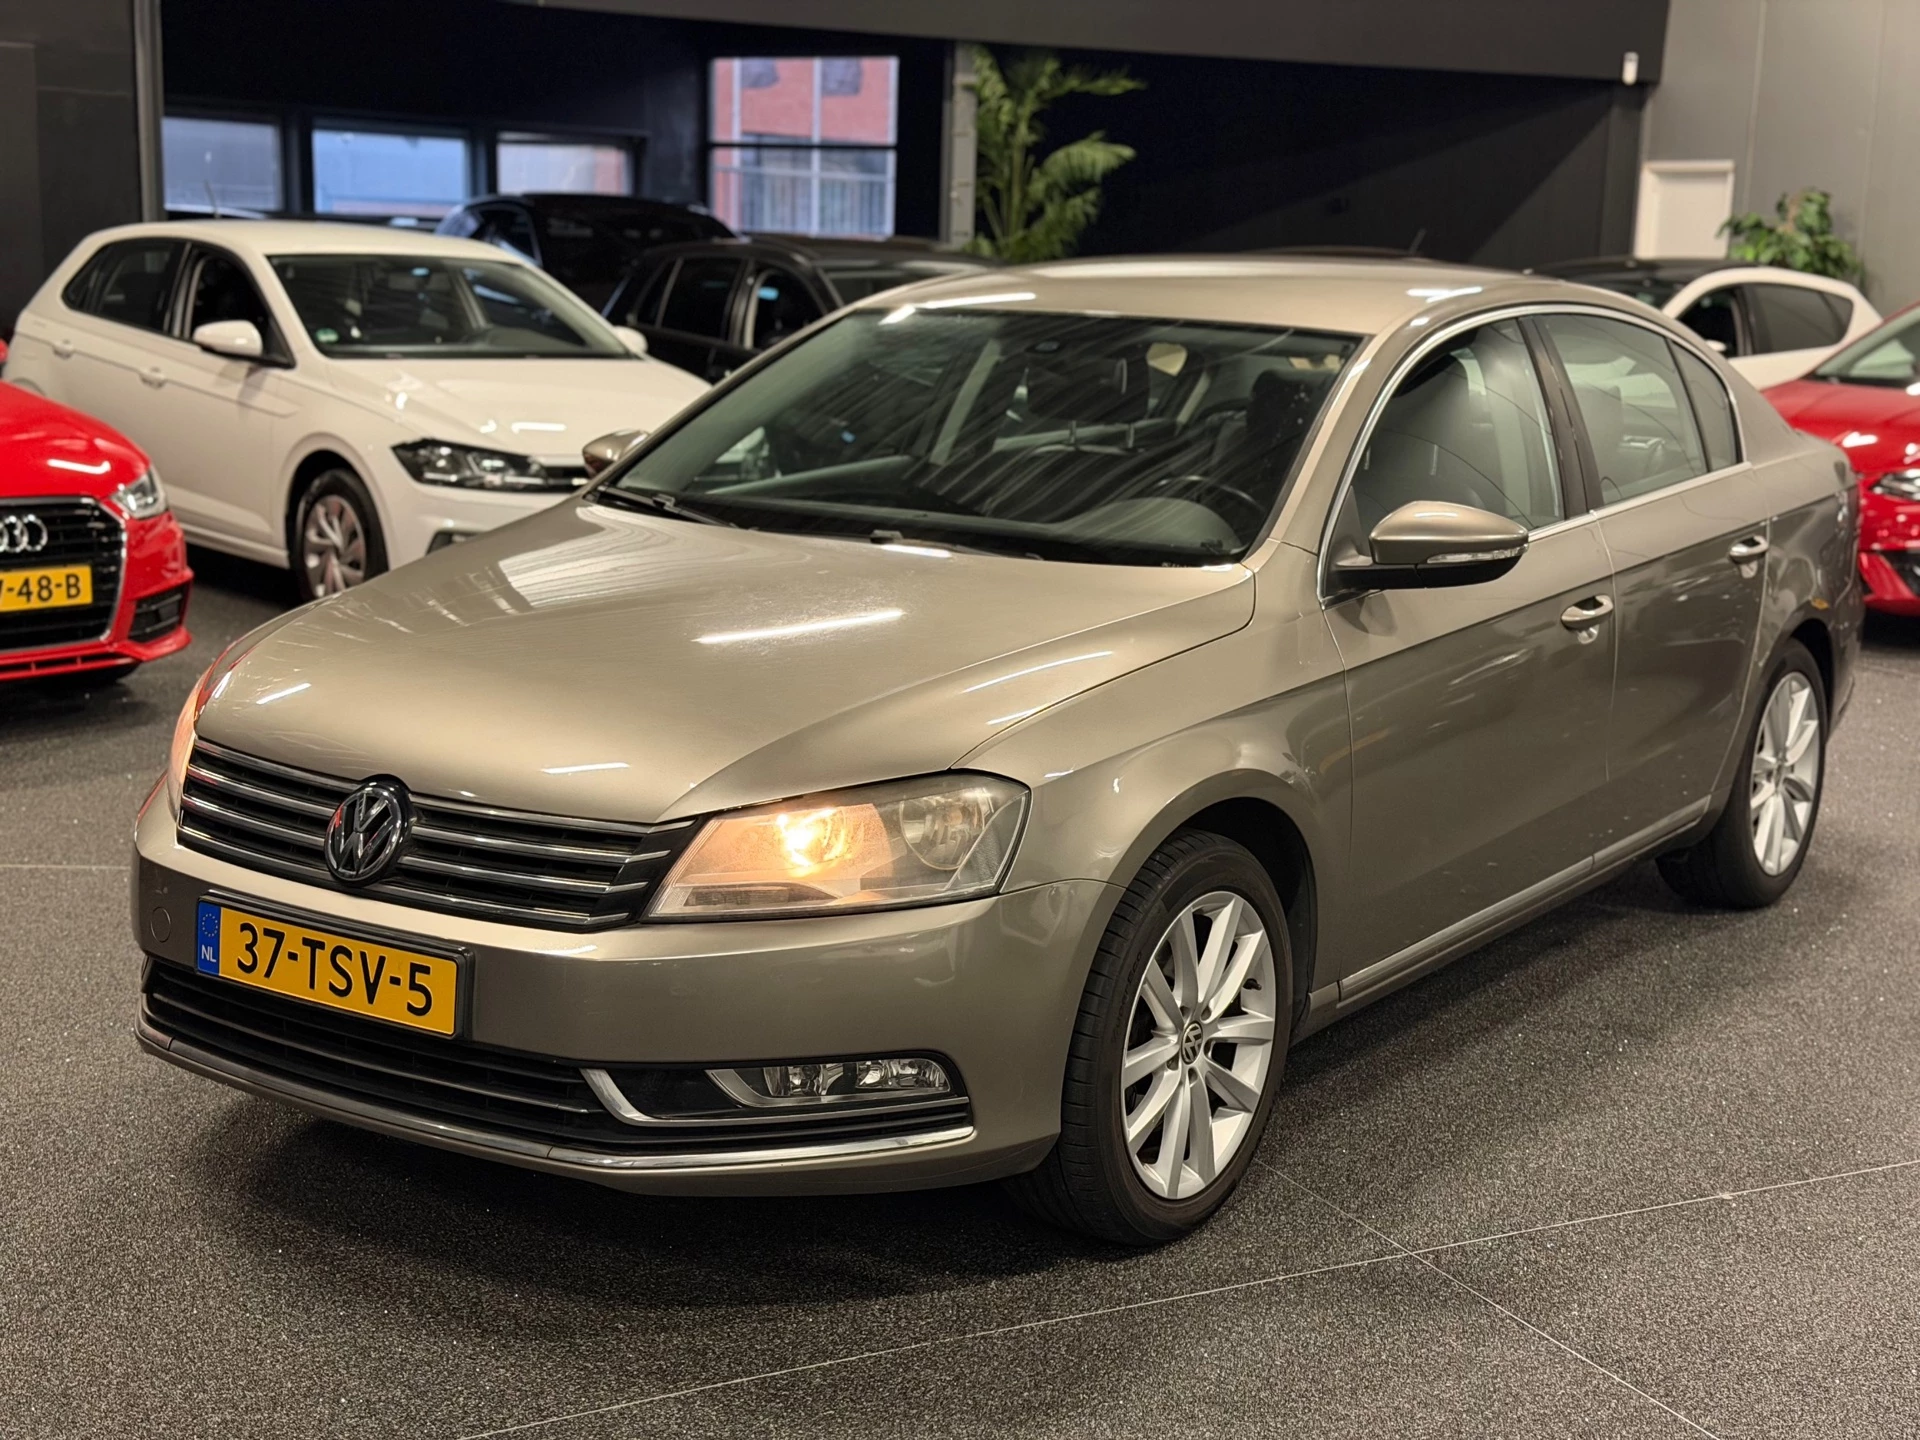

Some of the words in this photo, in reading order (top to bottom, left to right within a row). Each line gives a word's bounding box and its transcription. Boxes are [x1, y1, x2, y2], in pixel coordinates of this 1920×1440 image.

[0, 573, 81, 603] -48-B
[201, 944, 217, 963] NL
[237, 922, 433, 1017] 37-TSV-5
